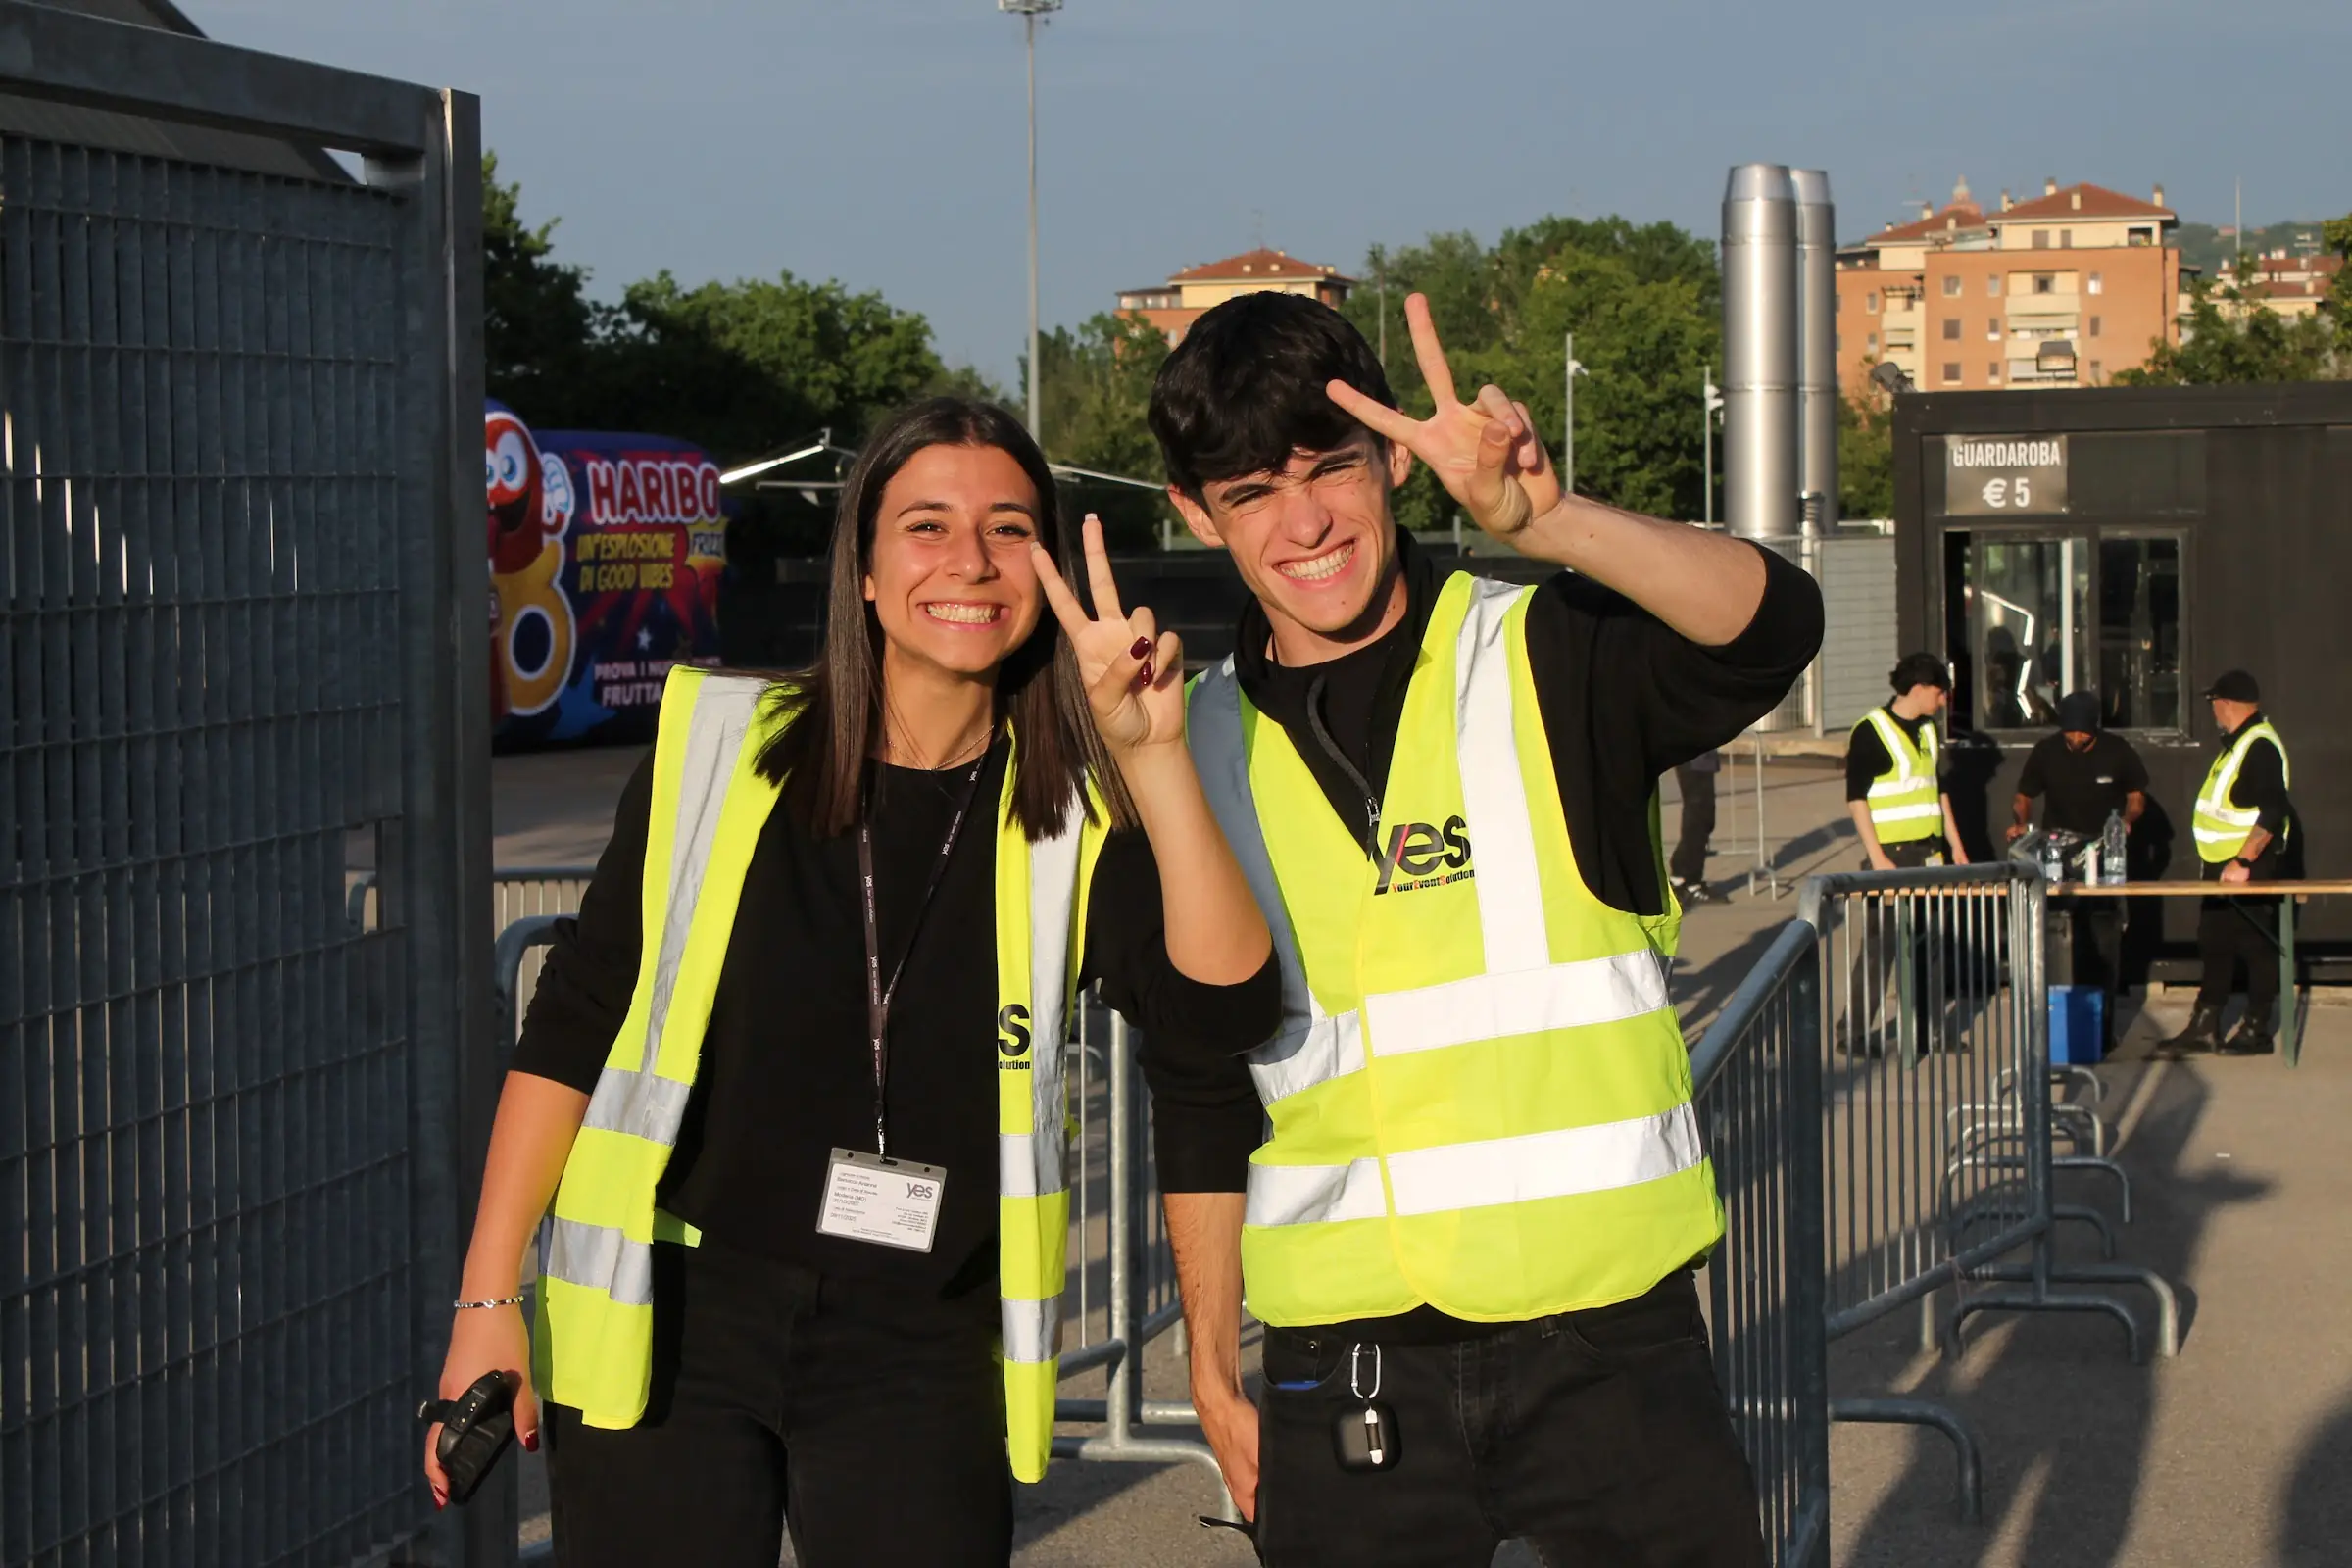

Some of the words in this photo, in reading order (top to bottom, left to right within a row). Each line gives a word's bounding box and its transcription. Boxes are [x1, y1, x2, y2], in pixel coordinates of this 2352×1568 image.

[1953, 442, 2061, 467] GUARDAROBA
[588, 460, 721, 524] HARIBO
[1983, 477, 2008, 508] €
[2014, 477, 2031, 507] 5
[597, 564, 636, 591] GOOD
[640, 563, 674, 589] VIBES
[594, 662, 636, 680] PROVA
[602, 682, 662, 707] FRUTTA
[1372, 815, 1471, 896] yes
[906, 1182, 933, 1199] yes
